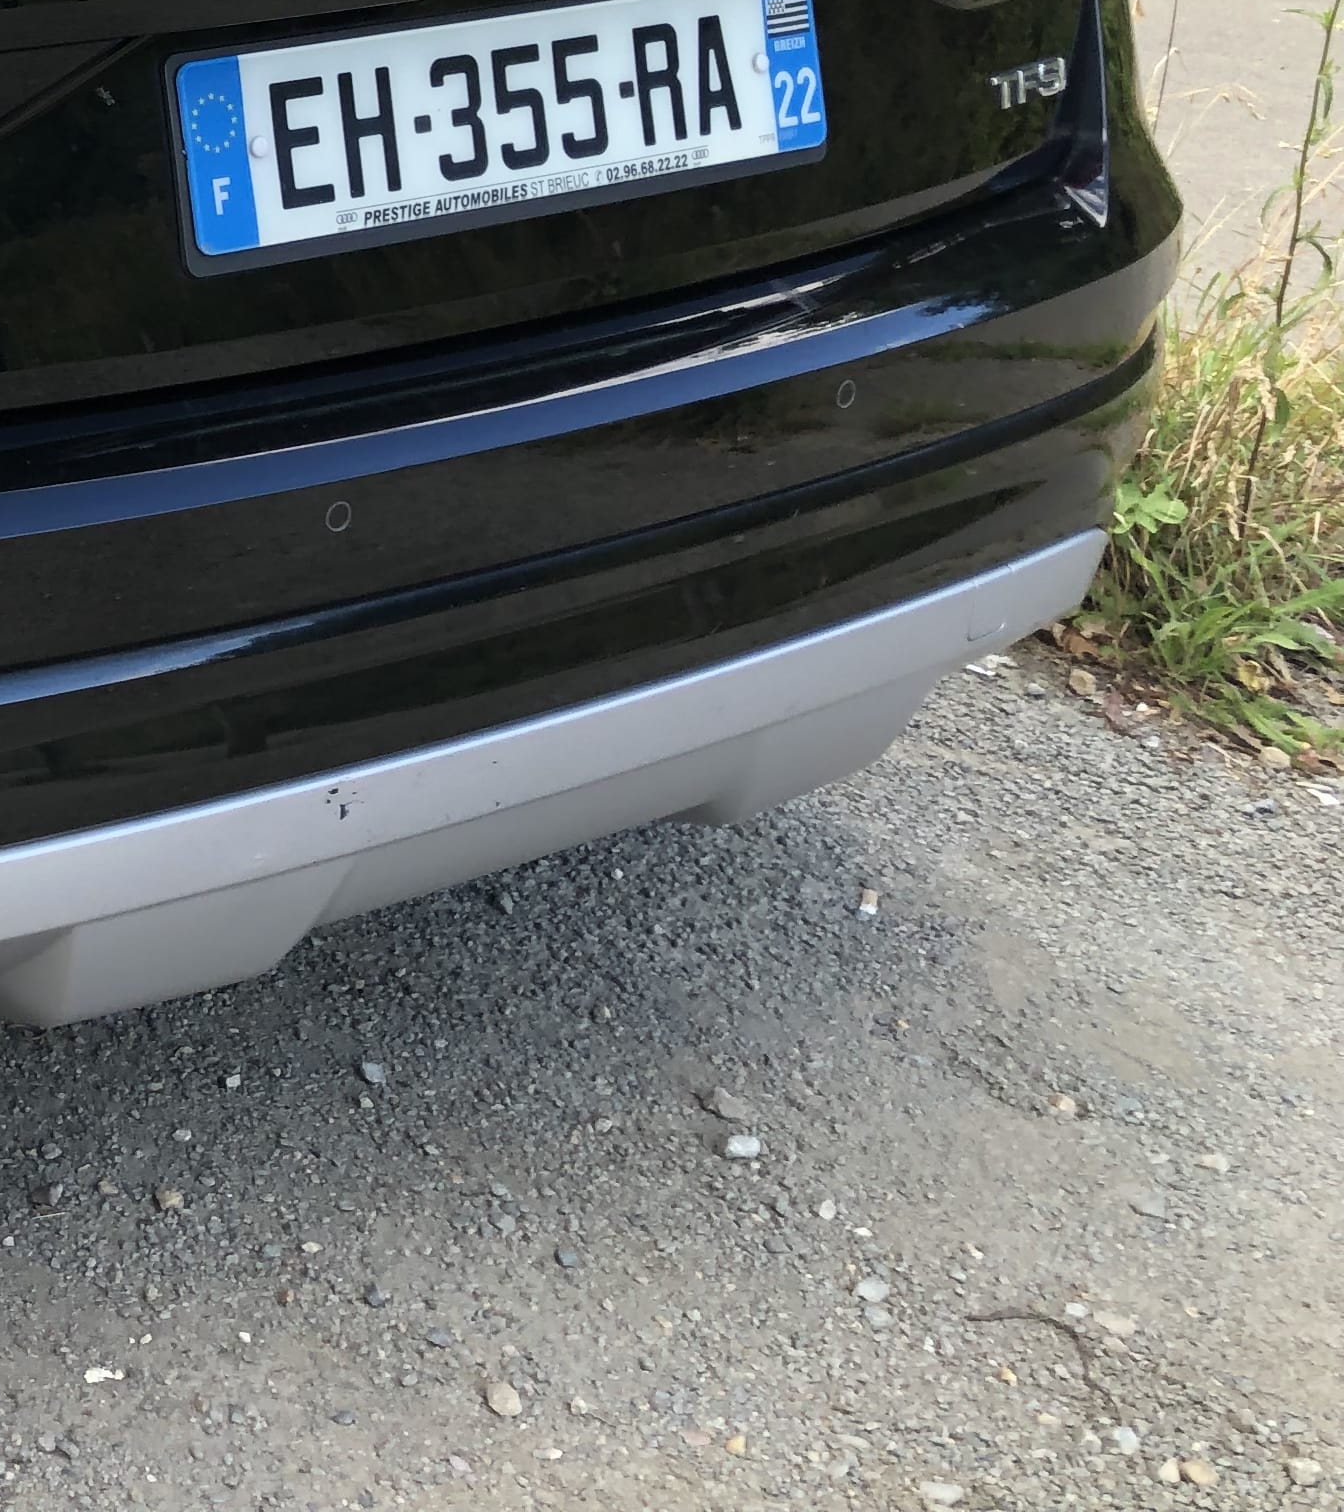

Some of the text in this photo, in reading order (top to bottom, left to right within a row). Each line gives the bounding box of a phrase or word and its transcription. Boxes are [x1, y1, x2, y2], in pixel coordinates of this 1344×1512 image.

[773, 35, 806, 53] BREIZH
[267, 14, 743, 210] EH-355-RA
[774, 66, 822, 128] 22
[989, 57, 1067, 110] TFSI
[211, 176, 232, 216] F
[363, 153, 689, 226] PRESTIGE AUTOMOBILES ST BRIEUC 02.96.68.22.22
